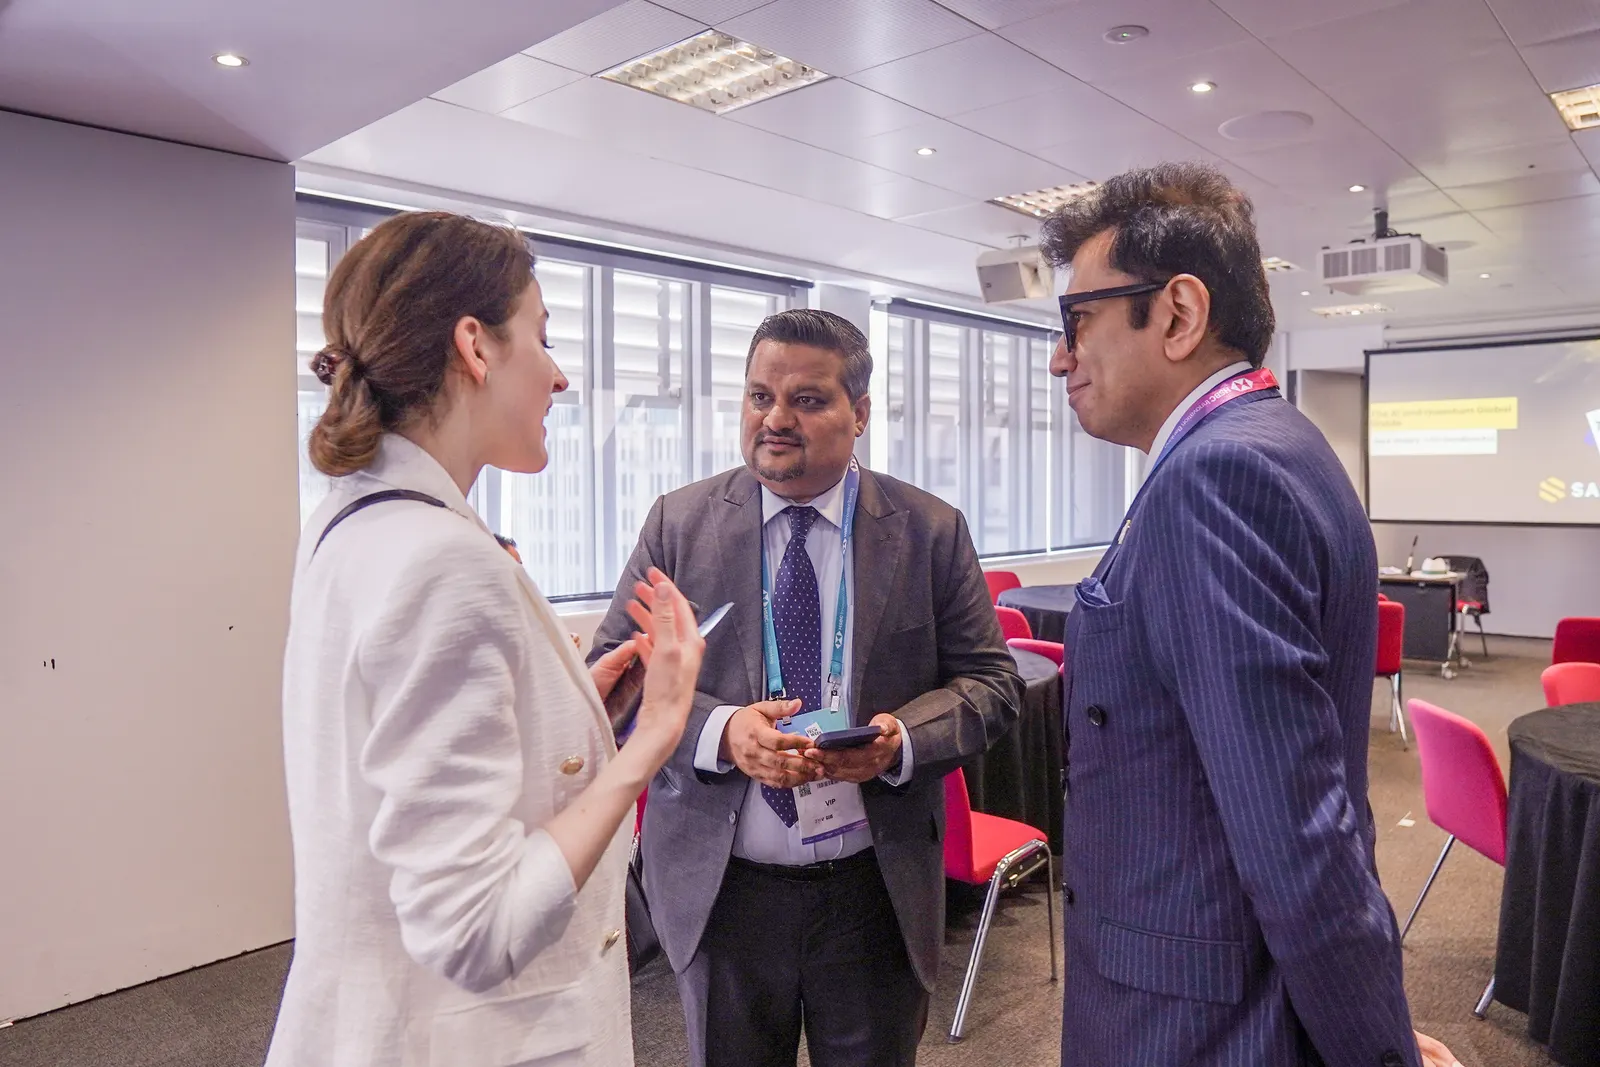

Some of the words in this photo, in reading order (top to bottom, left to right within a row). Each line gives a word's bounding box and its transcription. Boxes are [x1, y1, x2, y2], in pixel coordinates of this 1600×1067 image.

[1208, 386, 1232, 403] HSBC
[1181, 399, 1211, 427] Innovation
[824, 798, 836, 807] VIP
